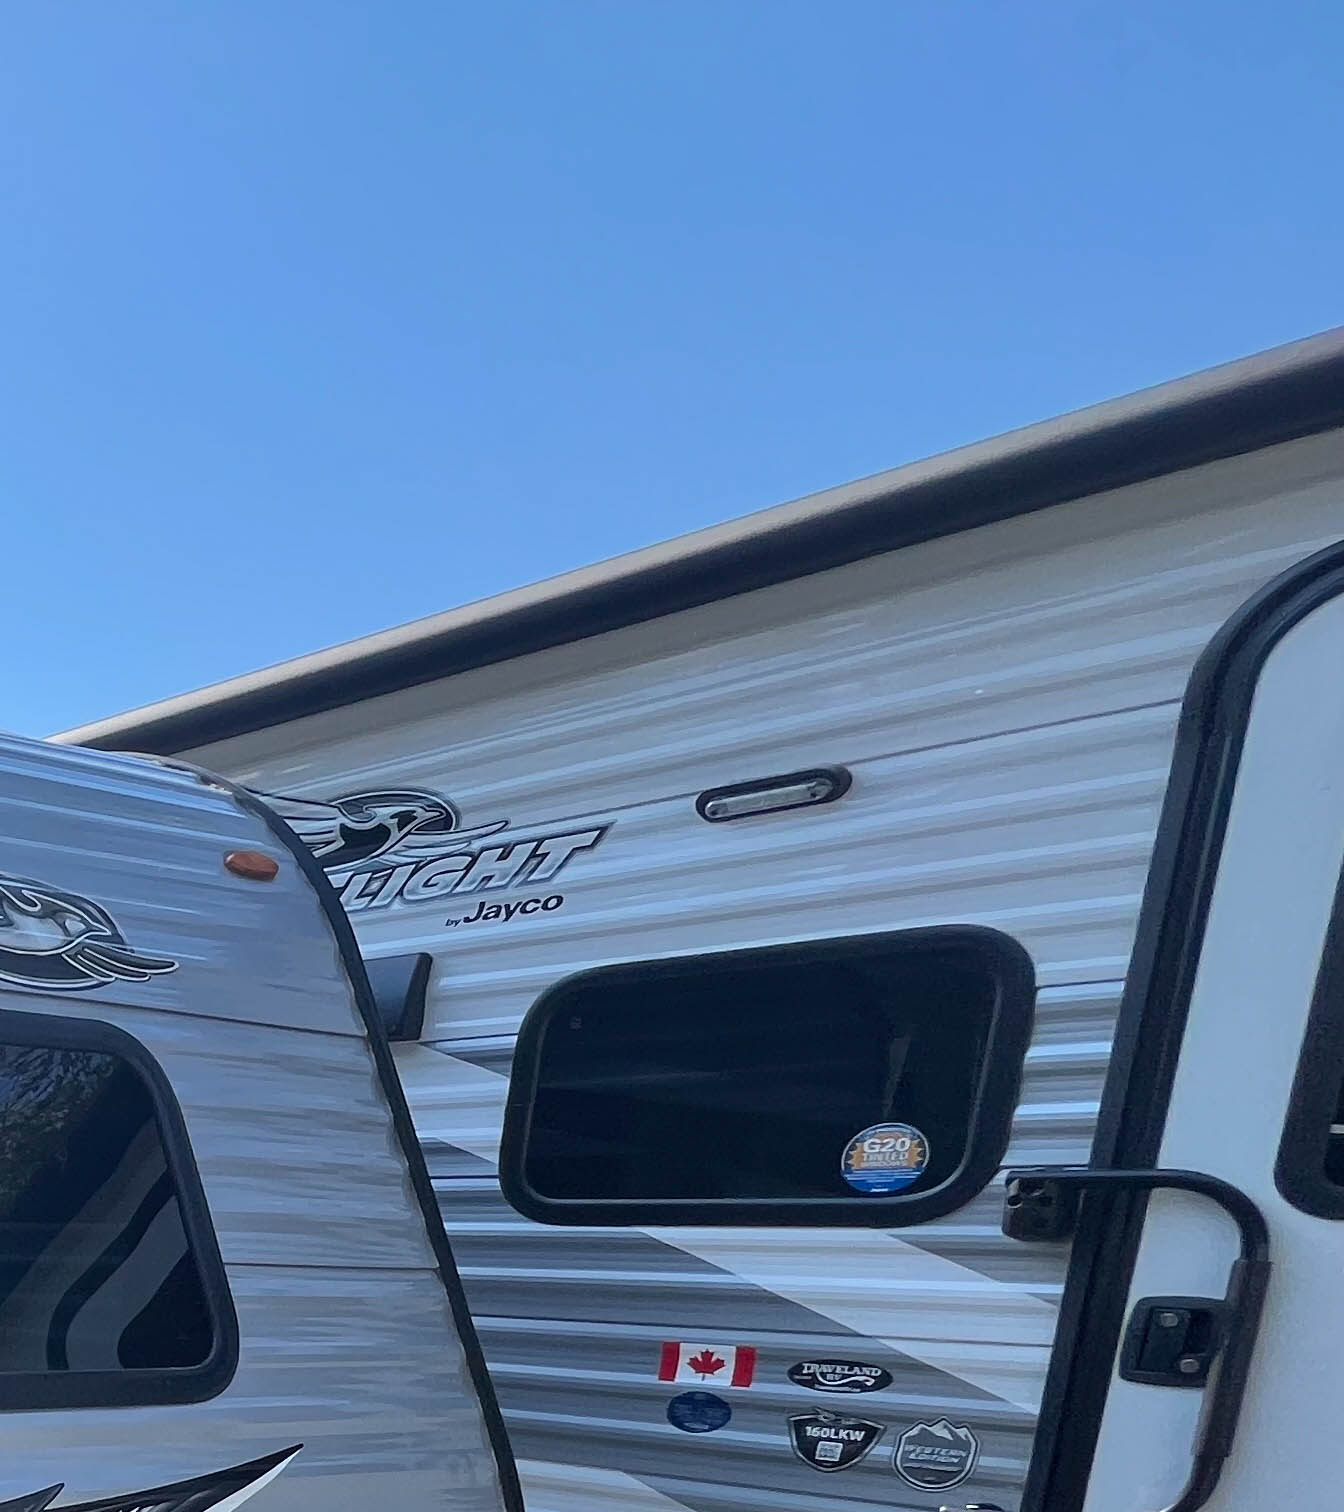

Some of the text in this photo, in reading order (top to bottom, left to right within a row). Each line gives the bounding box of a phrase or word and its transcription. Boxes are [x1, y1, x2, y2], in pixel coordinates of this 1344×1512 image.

[446, 895, 564, 927] by Jayco
[863, 1137, 911, 1152] G20
[863, 1151, 909, 1162] TINTED
[802, 1363, 882, 1377] TRAVELAND
[826, 1373, 843, 1381] RV
